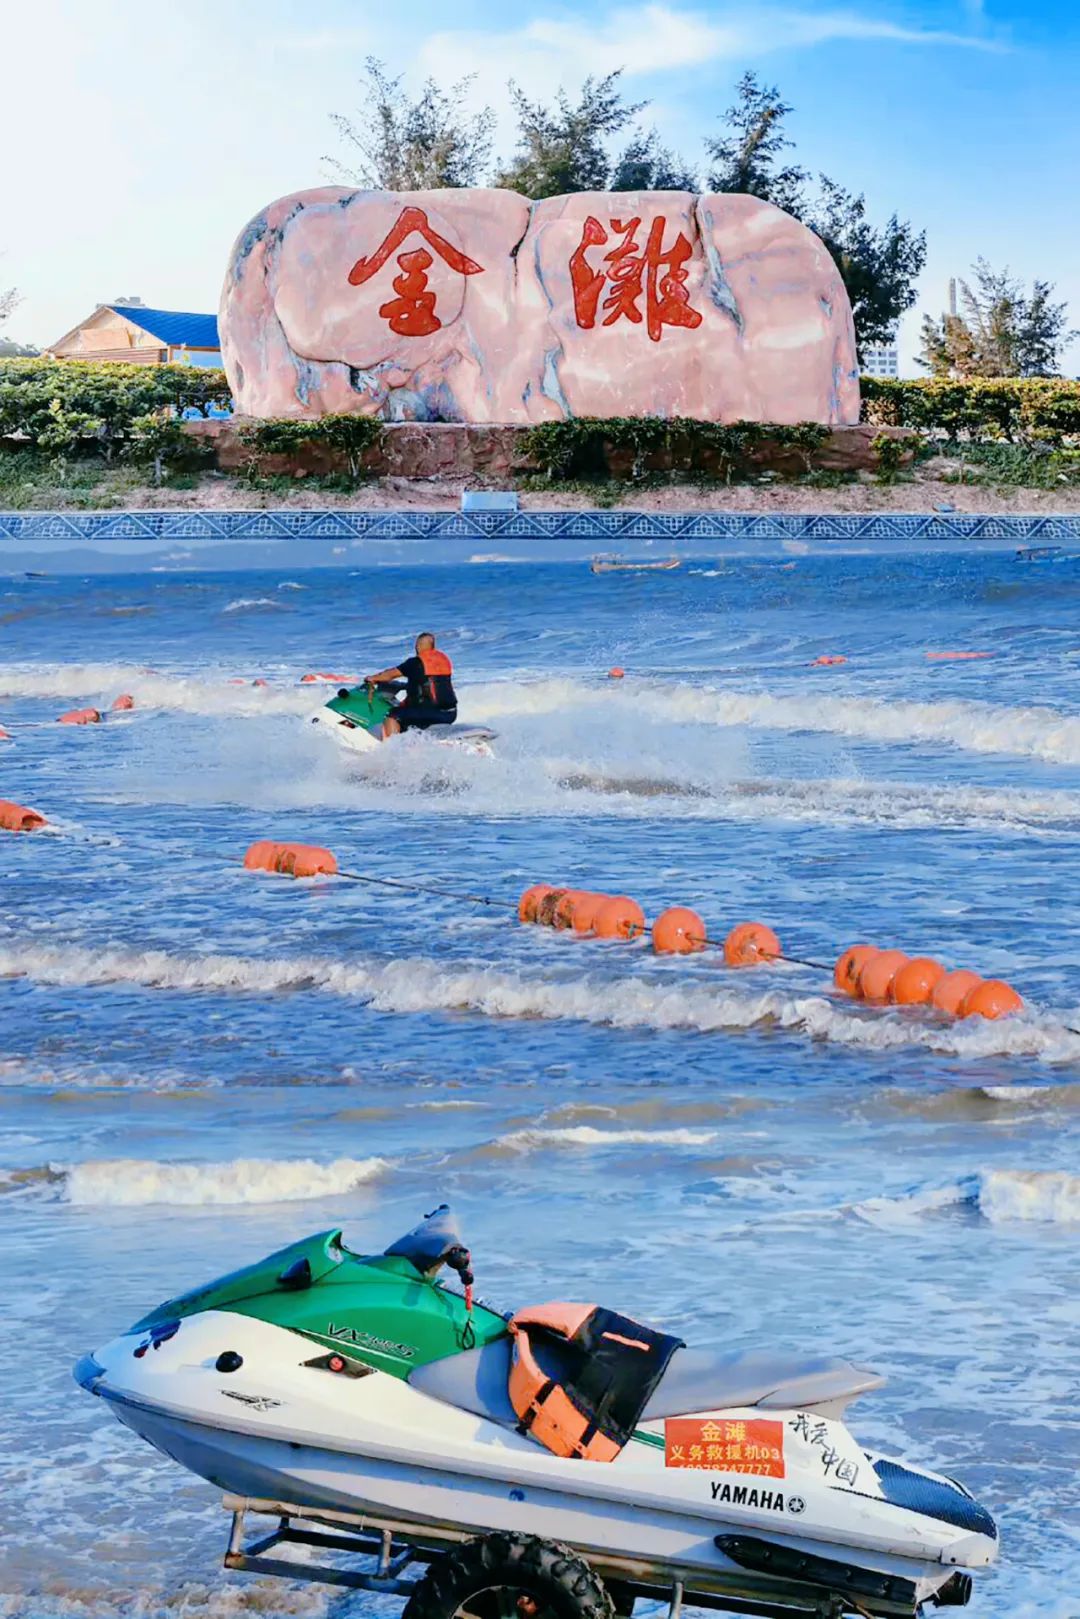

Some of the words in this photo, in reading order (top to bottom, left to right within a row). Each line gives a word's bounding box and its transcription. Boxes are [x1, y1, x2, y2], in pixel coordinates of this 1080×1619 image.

[700, 1420, 747, 1442] 金滩
[670, 1444, 780, 1461] 义务救援机03
[711, 1481, 784, 1512] YAMAHA
